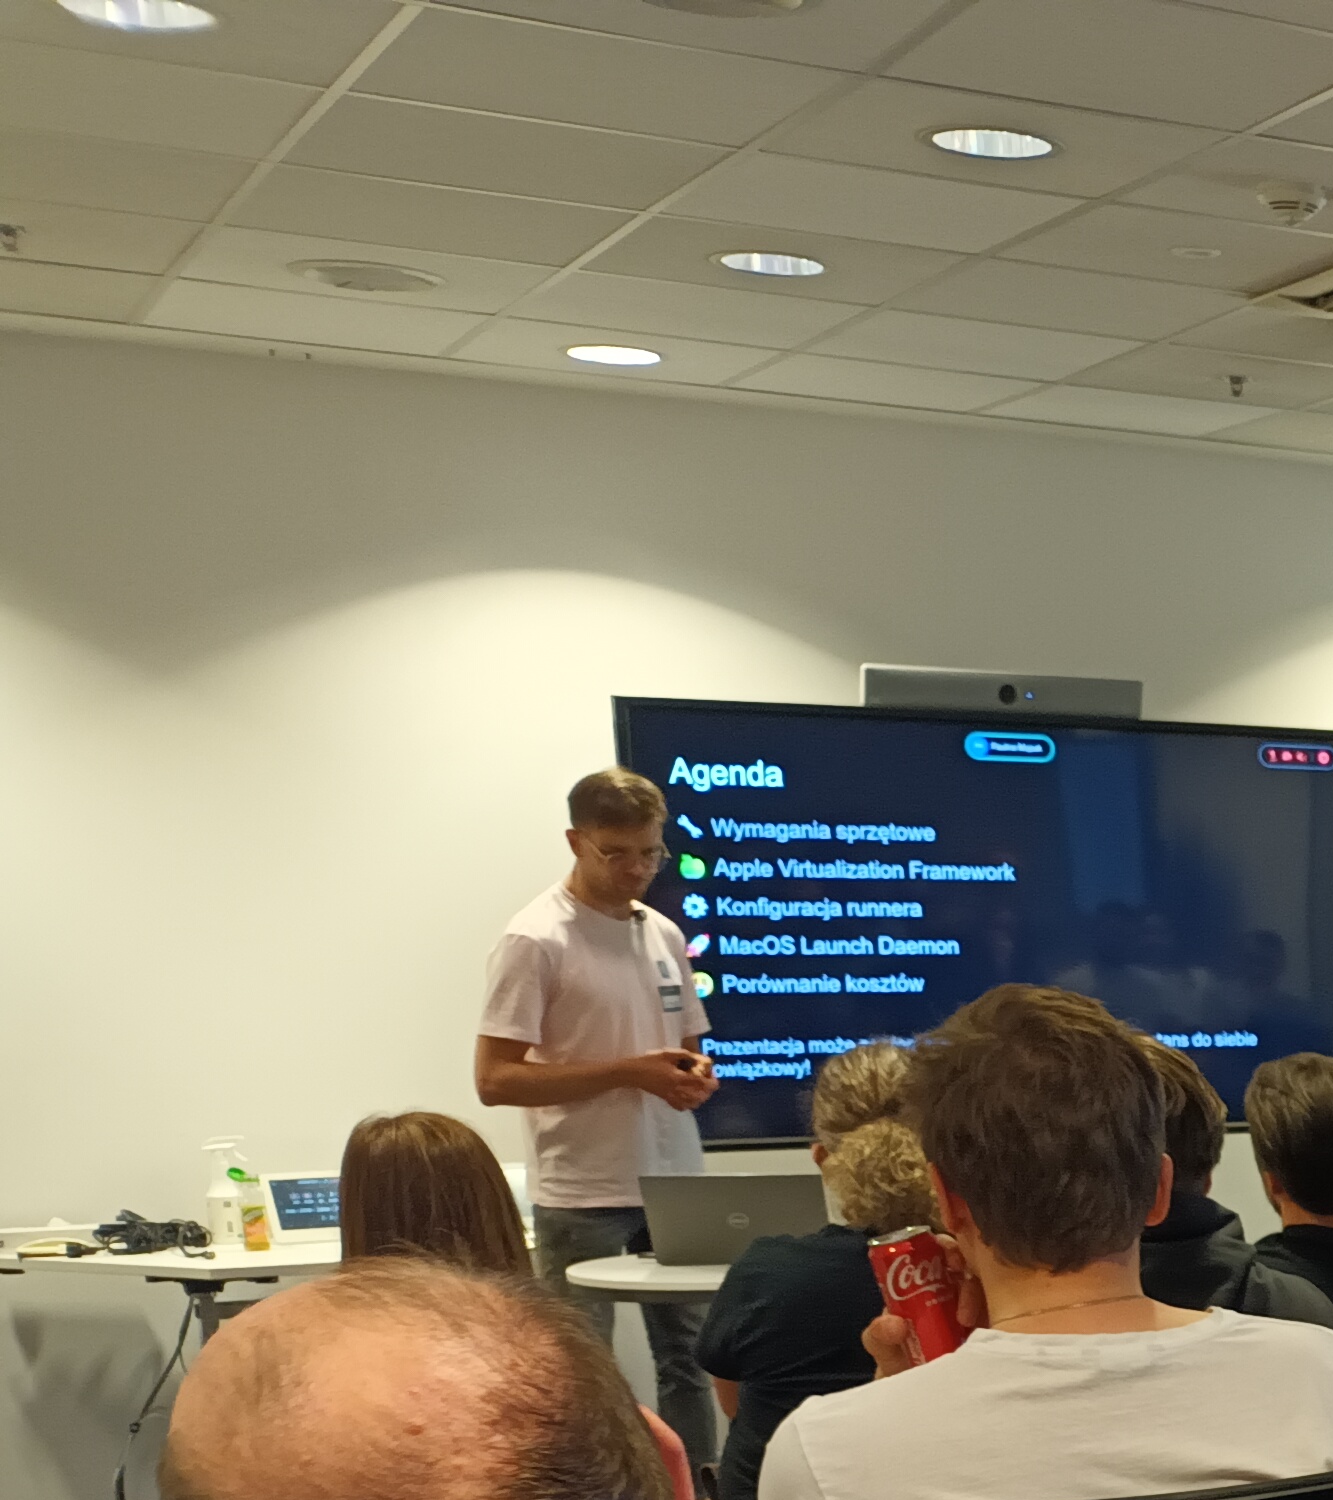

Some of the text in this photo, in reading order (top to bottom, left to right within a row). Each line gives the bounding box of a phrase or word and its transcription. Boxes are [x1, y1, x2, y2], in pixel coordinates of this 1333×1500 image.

[668, 757, 785, 792] Agenda
[710, 817, 937, 846] Wymagania sprzętowe
[713, 857, 1017, 882] Apple Virtualization Framework
[716, 896, 924, 921] Konfiguracja runnera
[718, 934, 961, 956] MacOS Launch Daemon
[721, 971, 926, 994] Porównanie kosztów
[702, 1036, 806, 1058] Prezentacja
[1190, 1031, 1213, 1048] do
[1213, 1030, 1259, 1048] siebie
